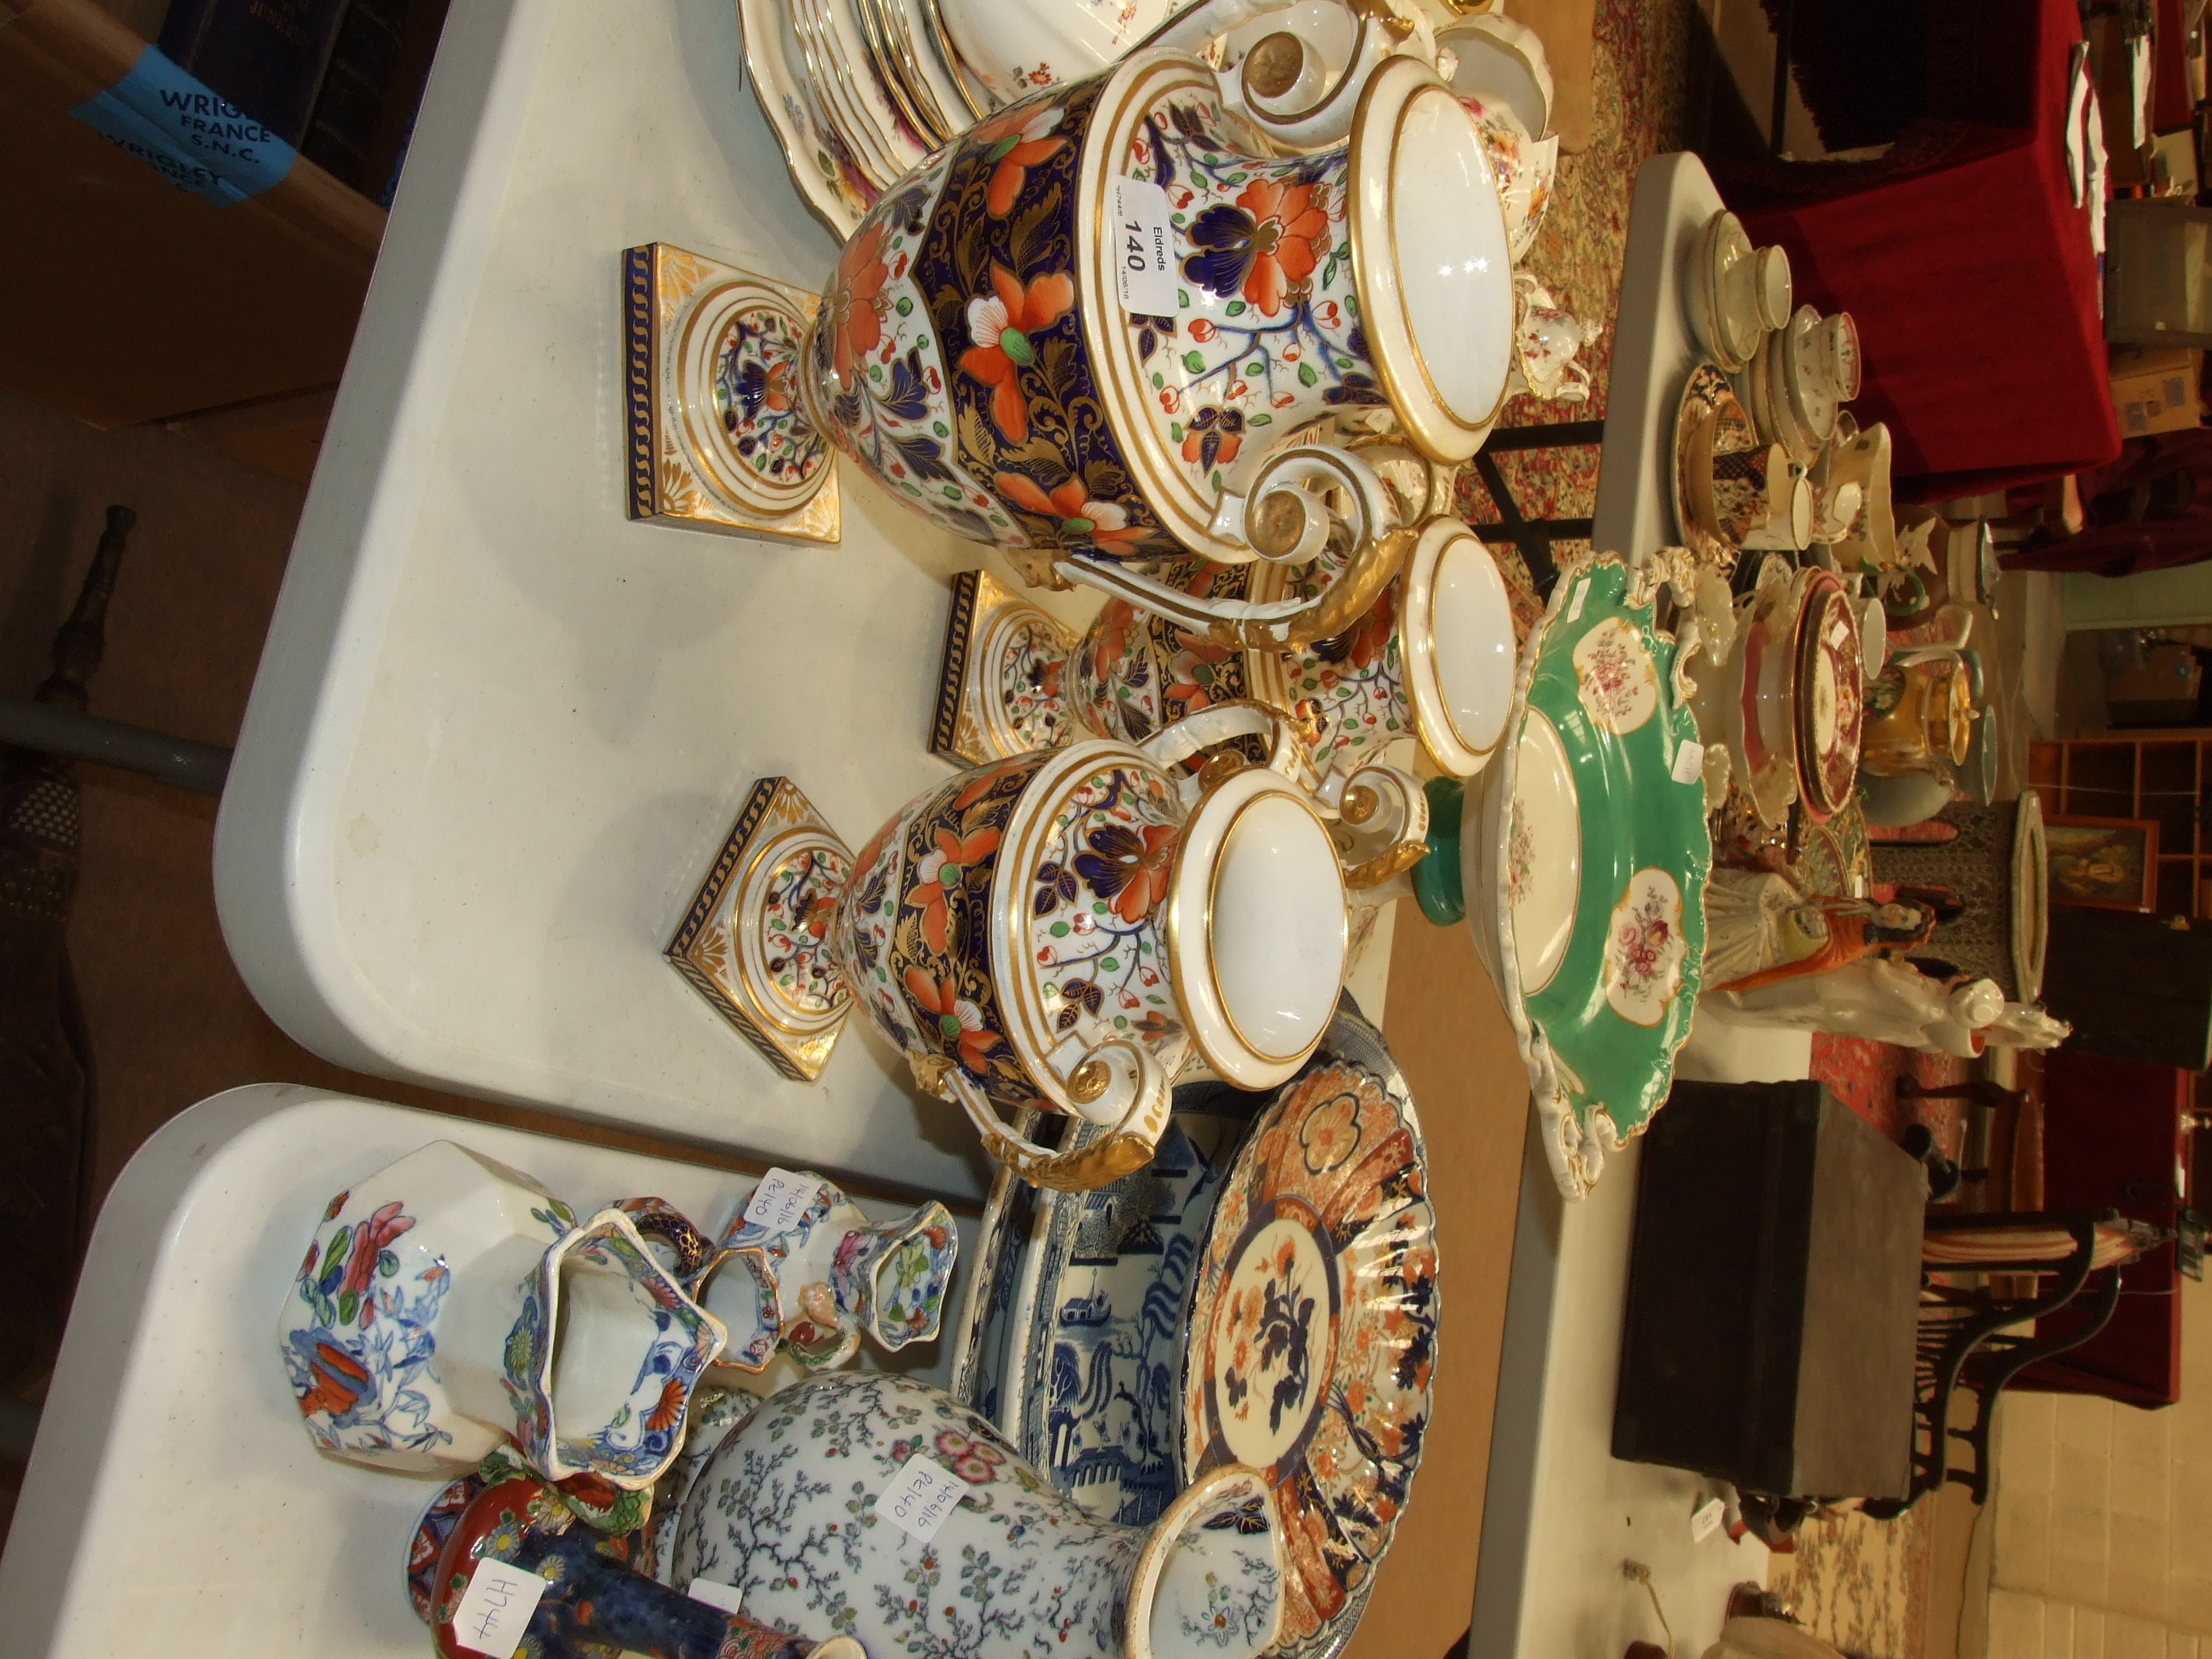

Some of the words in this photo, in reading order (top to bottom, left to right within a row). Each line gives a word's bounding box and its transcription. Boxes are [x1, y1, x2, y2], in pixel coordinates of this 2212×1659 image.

[160, 89, 252, 120] WRIG
[181, 115, 271, 144] FRANCE
[191, 134, 260, 164] S.N.C.
[1125, 220, 1146, 272] 140
[1153, 226, 1167, 271] Eldreds
[473, 1579, 519, 1639] H744
